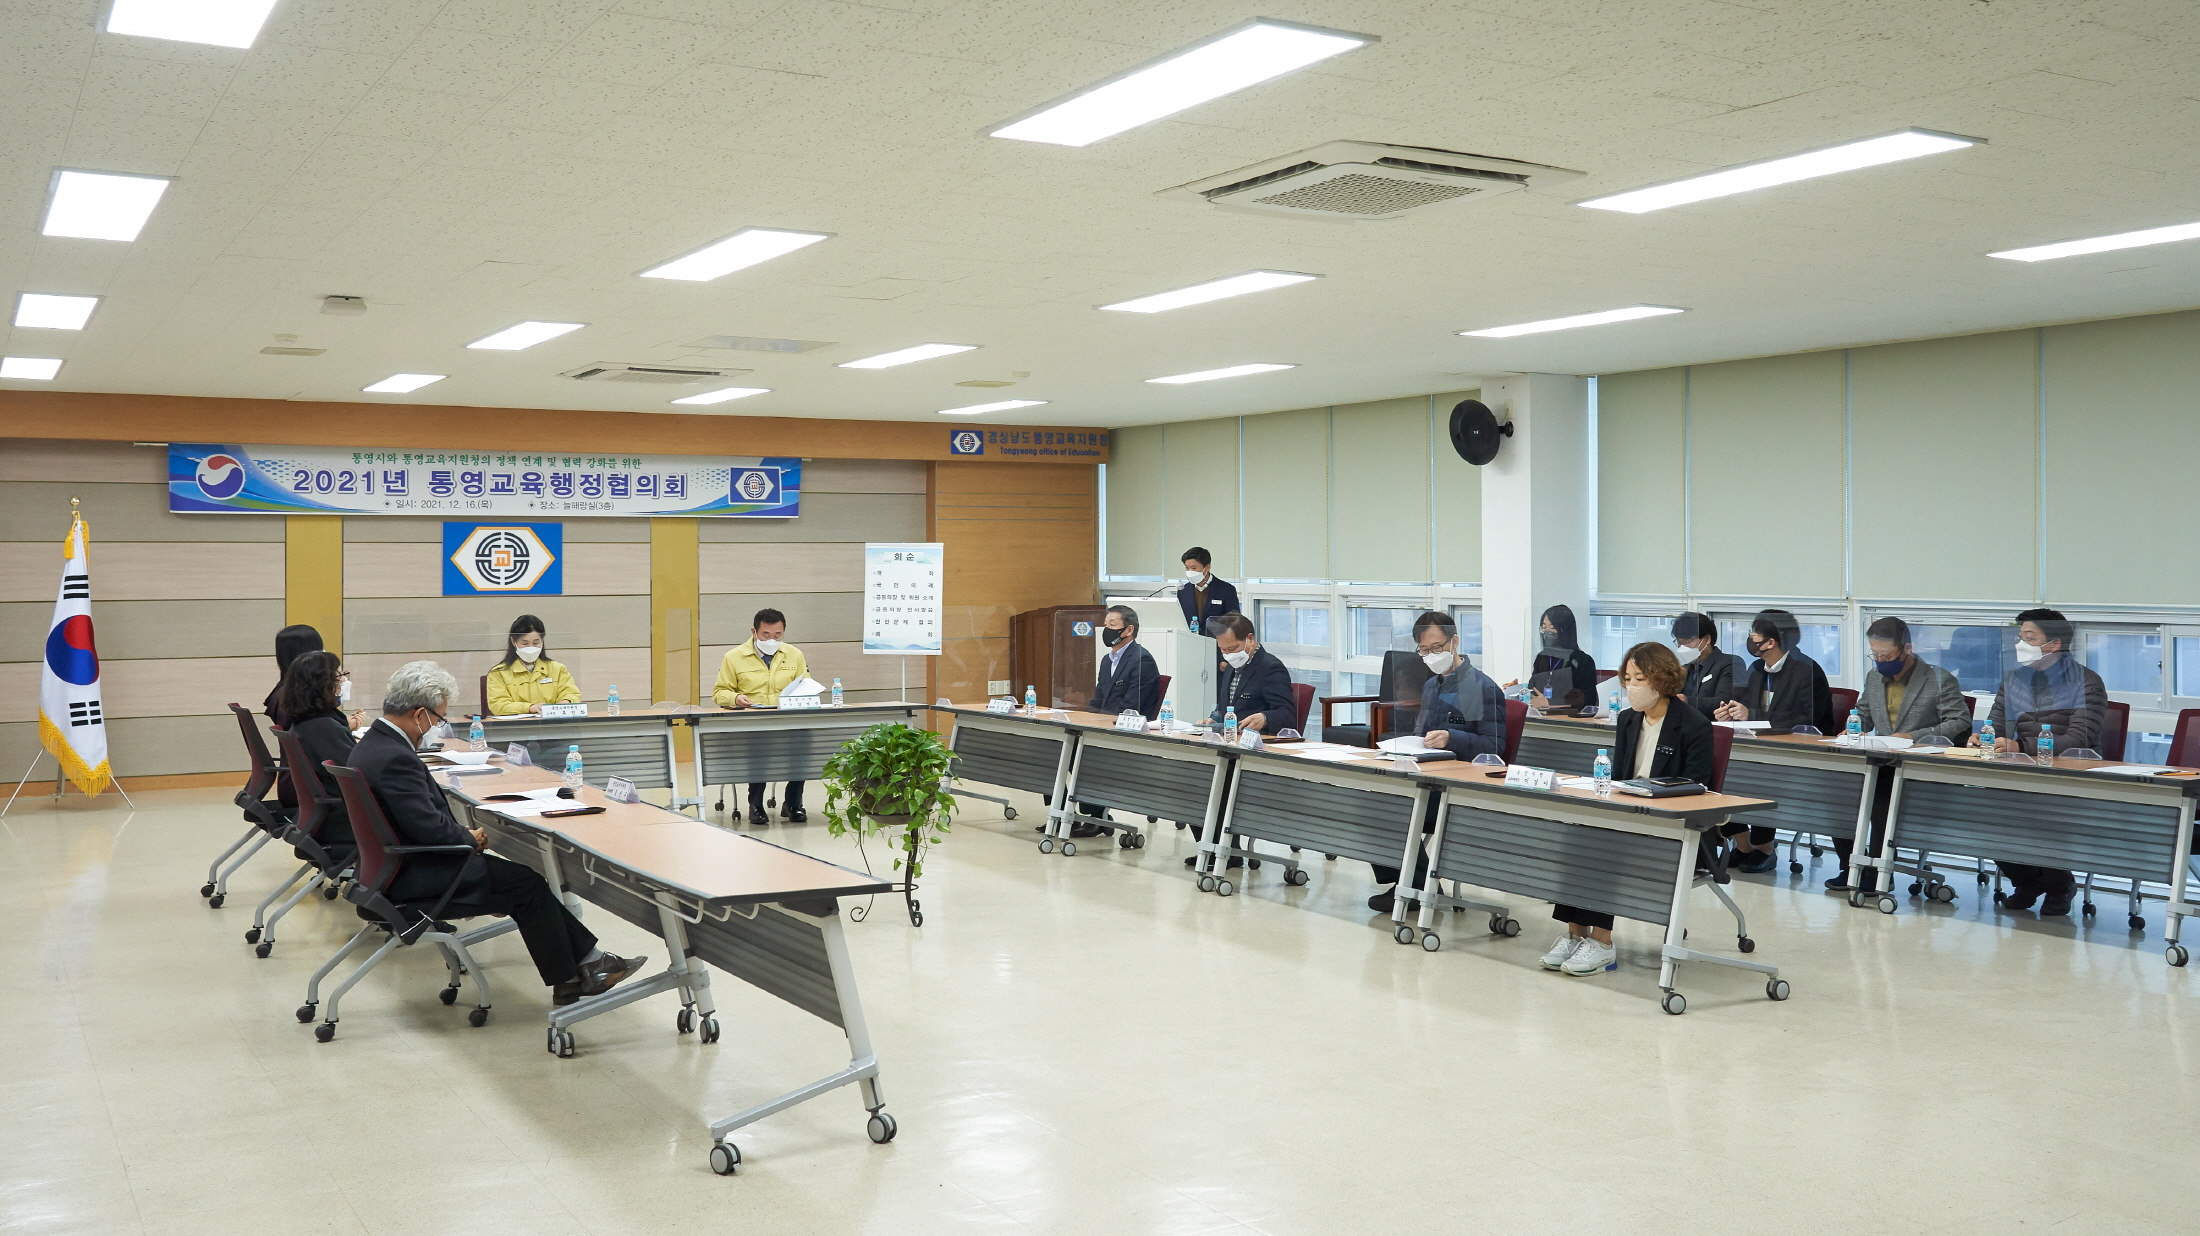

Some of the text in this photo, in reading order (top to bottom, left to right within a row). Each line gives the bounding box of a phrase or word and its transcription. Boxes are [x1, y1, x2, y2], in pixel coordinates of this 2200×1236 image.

[1000, 447, 1037, 456] Tongyeong
[1039, 448, 1058, 456] office
[1060, 448, 1067, 456] of
[351, 452, 642, 469] 통영시와 통영교육지원청의 정책 연계 및 협력 강화를 위한
[293, 469, 688, 499] 2021년 통영교육행정협의회
[395, 500, 417, 509] 일시:
[420, 500, 445, 509] 2021.
[539, 501, 559, 510] 장소:
